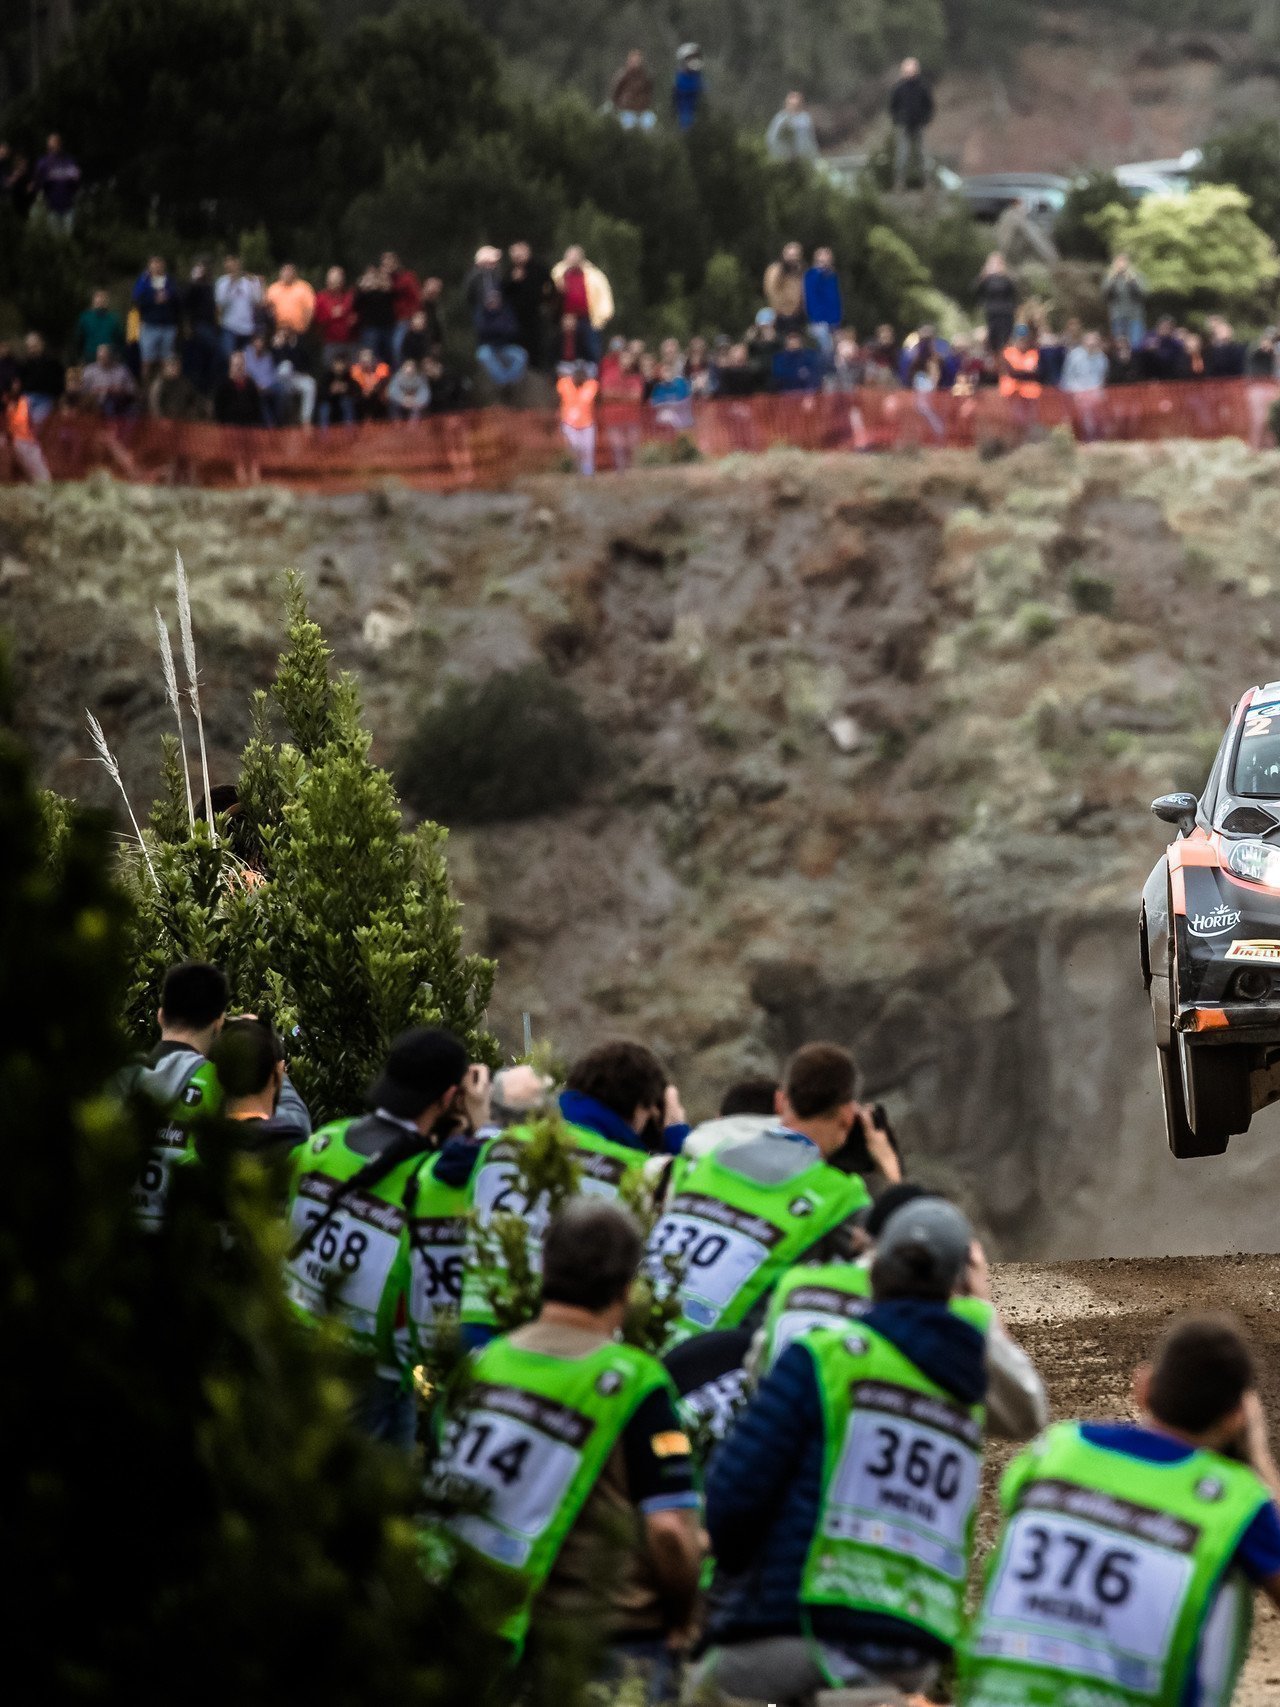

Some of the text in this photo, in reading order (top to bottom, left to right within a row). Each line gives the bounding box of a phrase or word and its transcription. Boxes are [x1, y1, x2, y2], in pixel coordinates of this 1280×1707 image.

[1245, 718, 1273, 737] 2
[1191, 910, 1242, 931] HORTEX
[1232, 944, 1280, 957] PIRELLI
[867, 1428, 961, 1501] 360
[1017, 1527, 1137, 1604] 376
